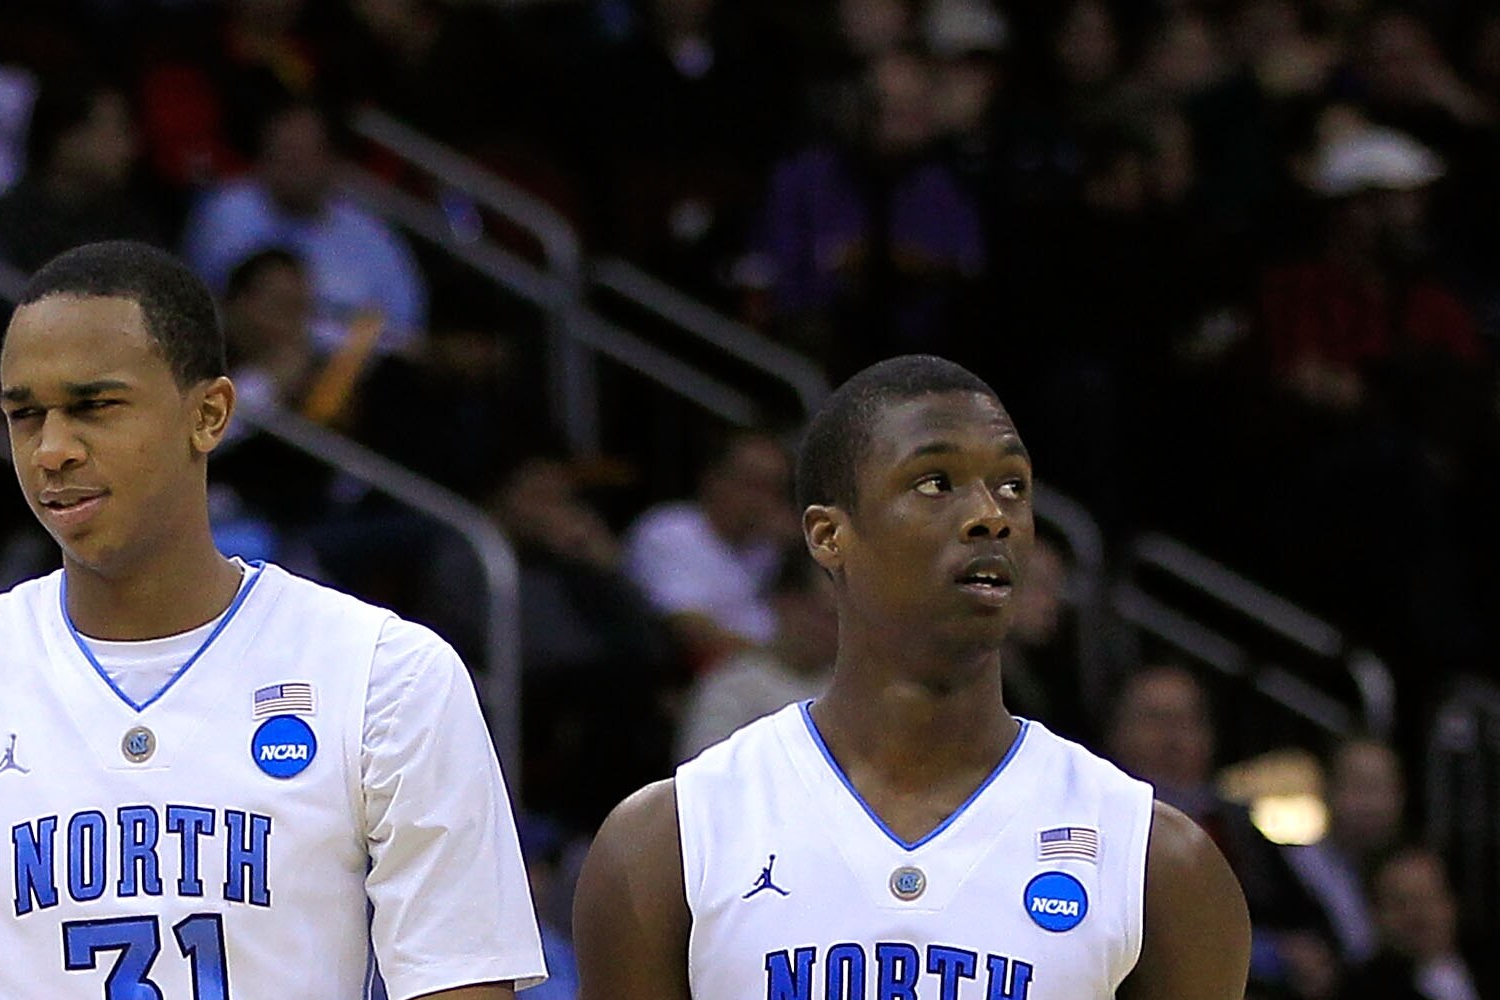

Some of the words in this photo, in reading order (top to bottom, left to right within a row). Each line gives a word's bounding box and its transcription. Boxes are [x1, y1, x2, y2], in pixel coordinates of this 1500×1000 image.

[261, 744, 308, 761] NCAA
[12, 804, 272, 916] NORTH
[1032, 897, 1079, 917] NCAA
